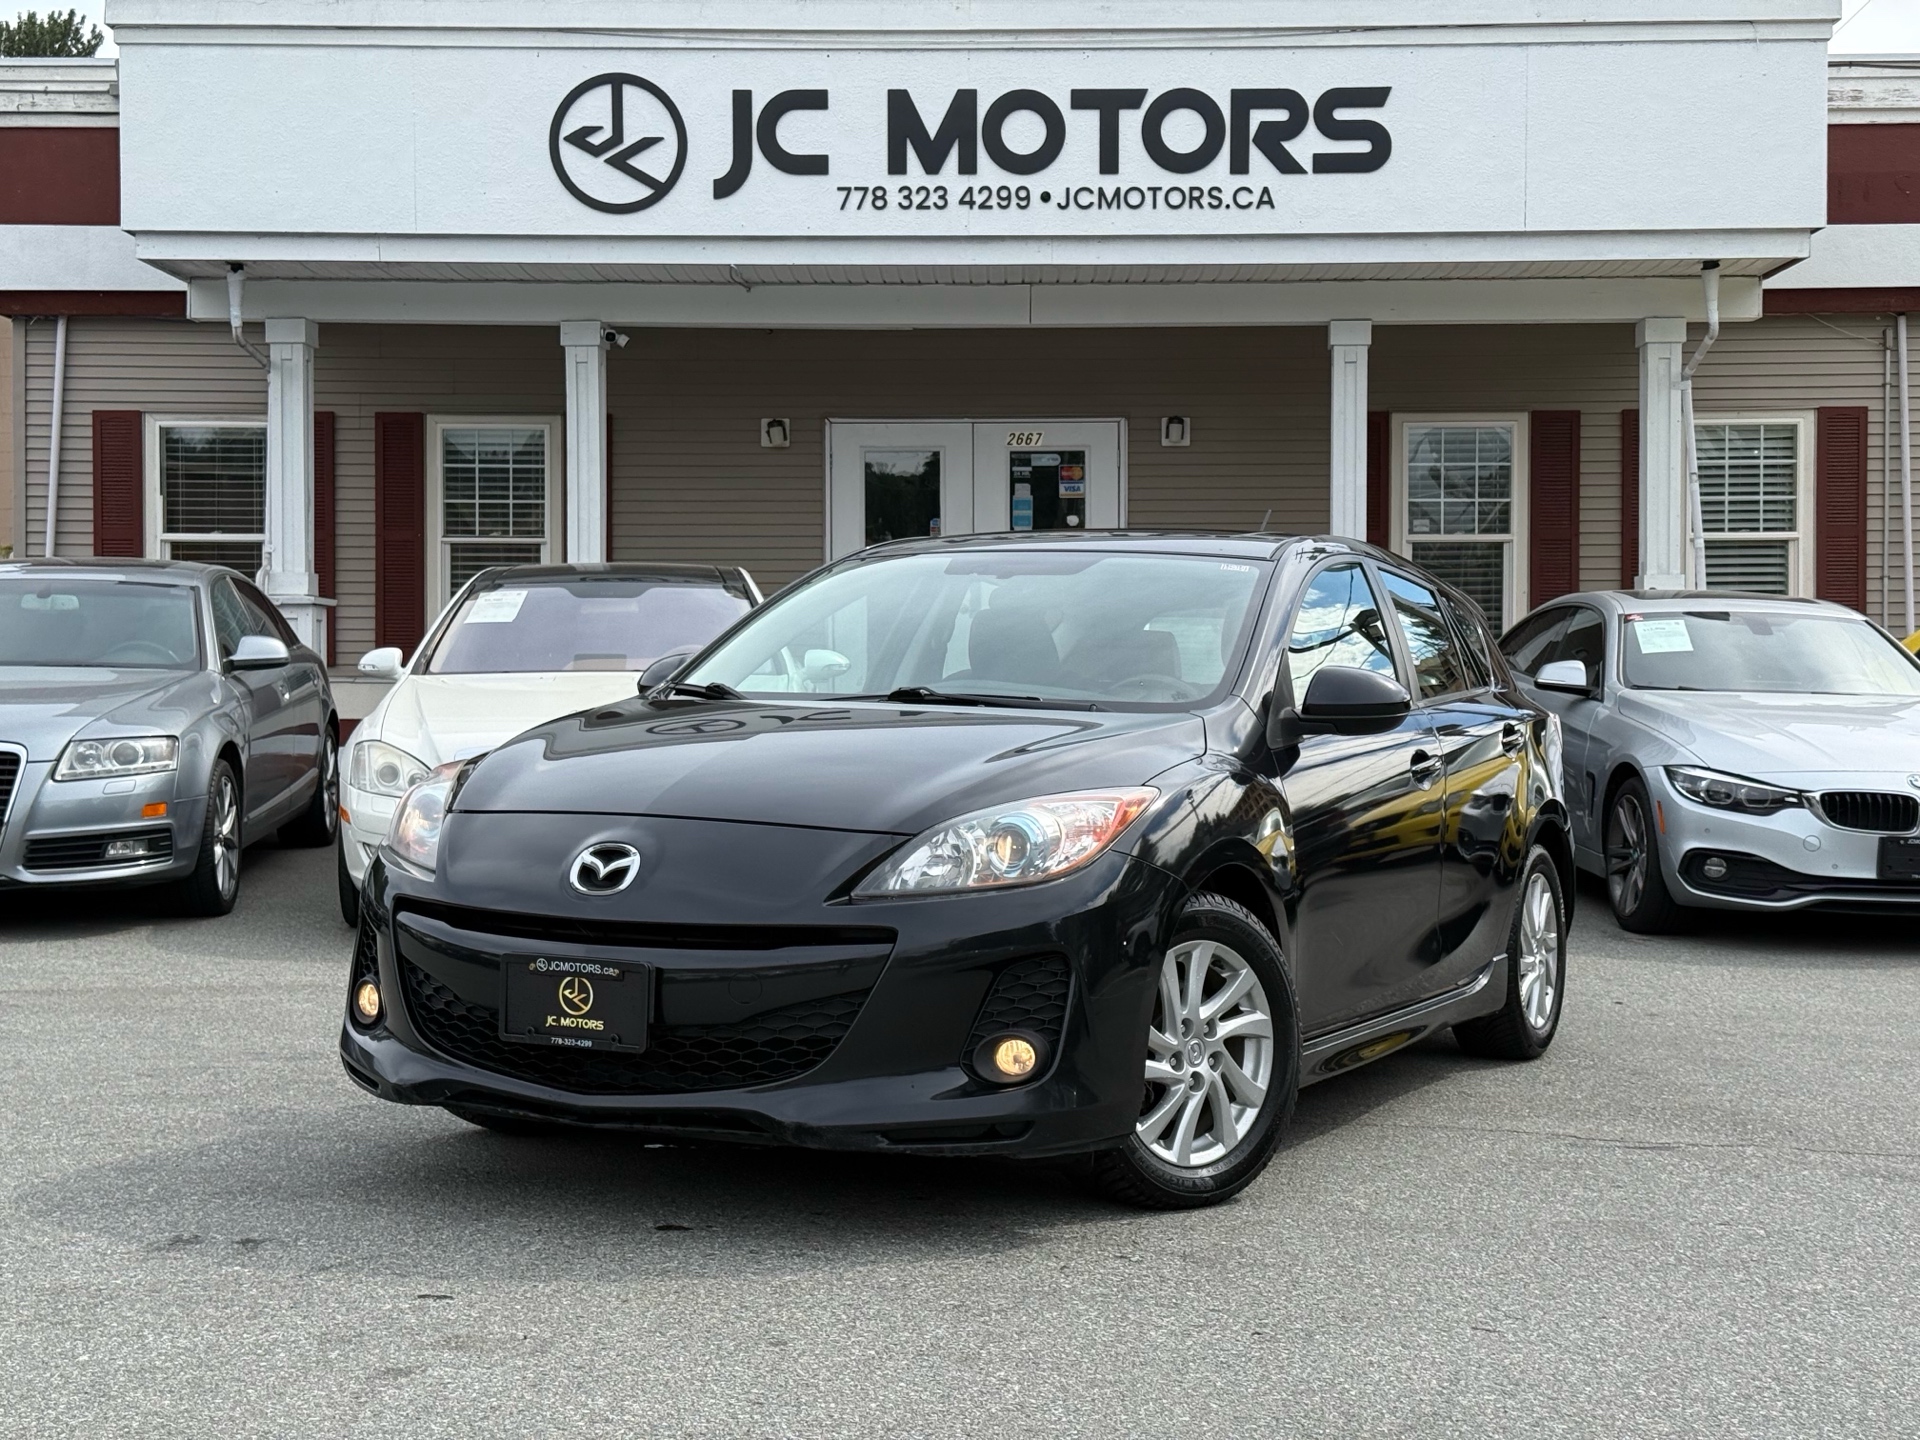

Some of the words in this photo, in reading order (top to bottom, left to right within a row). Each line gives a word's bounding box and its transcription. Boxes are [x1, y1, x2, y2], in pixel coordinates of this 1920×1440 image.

[714, 90, 829, 199] JC
[887, 87, 1393, 175] MOTORS
[837, 186, 888, 211] 778
[897, 186, 949, 211] 323
[958, 186, 1032, 210] 4299
[1056, 186, 1276, 211] JCMOTORS.CA
[1006, 432, 1043, 446] 2667
[548, 960, 614, 976] JCMOTORS.ca
[560, 1016, 604, 1031] MOTORS
